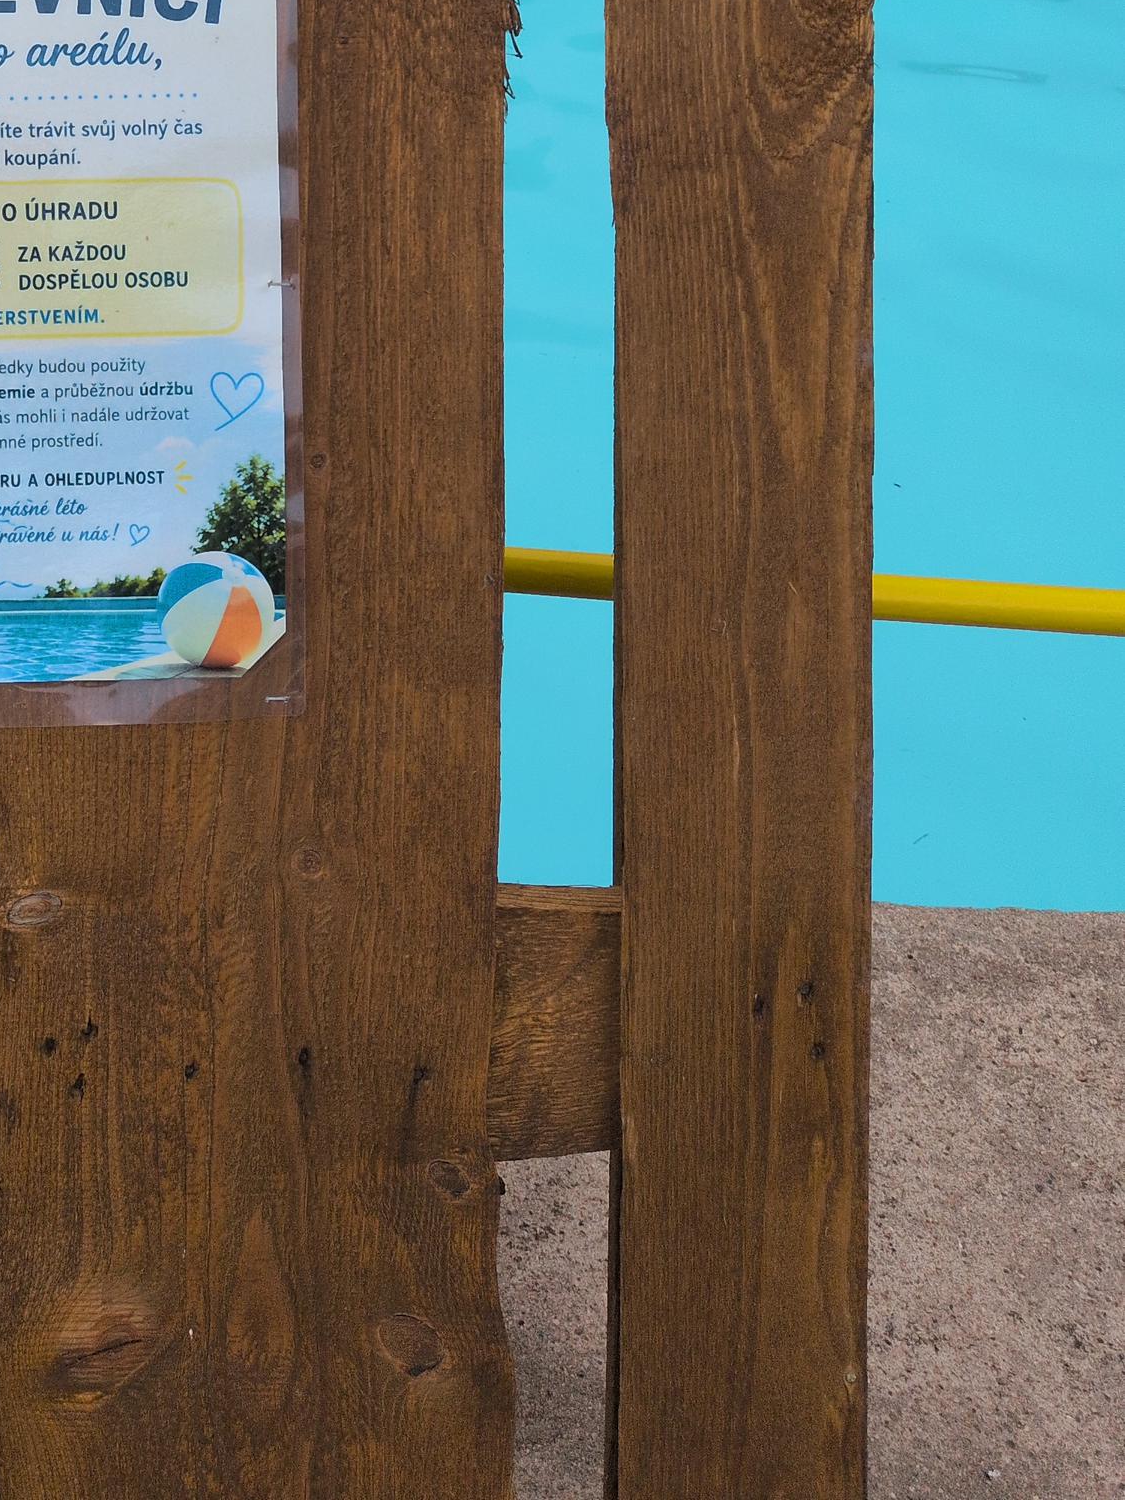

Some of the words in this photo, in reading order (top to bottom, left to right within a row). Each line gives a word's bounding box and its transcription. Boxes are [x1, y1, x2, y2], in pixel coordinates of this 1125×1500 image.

[25, 27, 162, 71] areálu,
[27, 120, 76, 138] trávit
[81, 119, 116, 141] svůj
[121, 118, 169, 141] volný
[173, 118, 203, 136] čas
[4, 148, 81, 170] koupání.
[1, 202, 17, 222] O
[25, 197, 118, 222] ÚHRADU
[17, 246, 42, 263] ZA
[48, 240, 126, 262] KAŽDOU
[18, 268, 118, 291] DOSPĚLOU
[124, 270, 189, 289] OSOBU
[38, 358, 86, 374] budou
[90, 357, 146, 377] použity
[40, 387, 50, 399] a
[54, 382, 134, 403] průběžnou
[139, 381, 194, 397] údržbu
[15, 408, 57, 424] mohli
[71, 406, 120, 423] nadále
[125, 406, 190, 422] udržovat
[31, 432, 103, 452] prostředí.
[27, 473, 39, 488] A
[44, 470, 165, 487] OHLEDUPLNOST
[55, 497, 88, 516] léto
[61, 530, 74, 542] u
[78, 522, 120, 542] nás!
